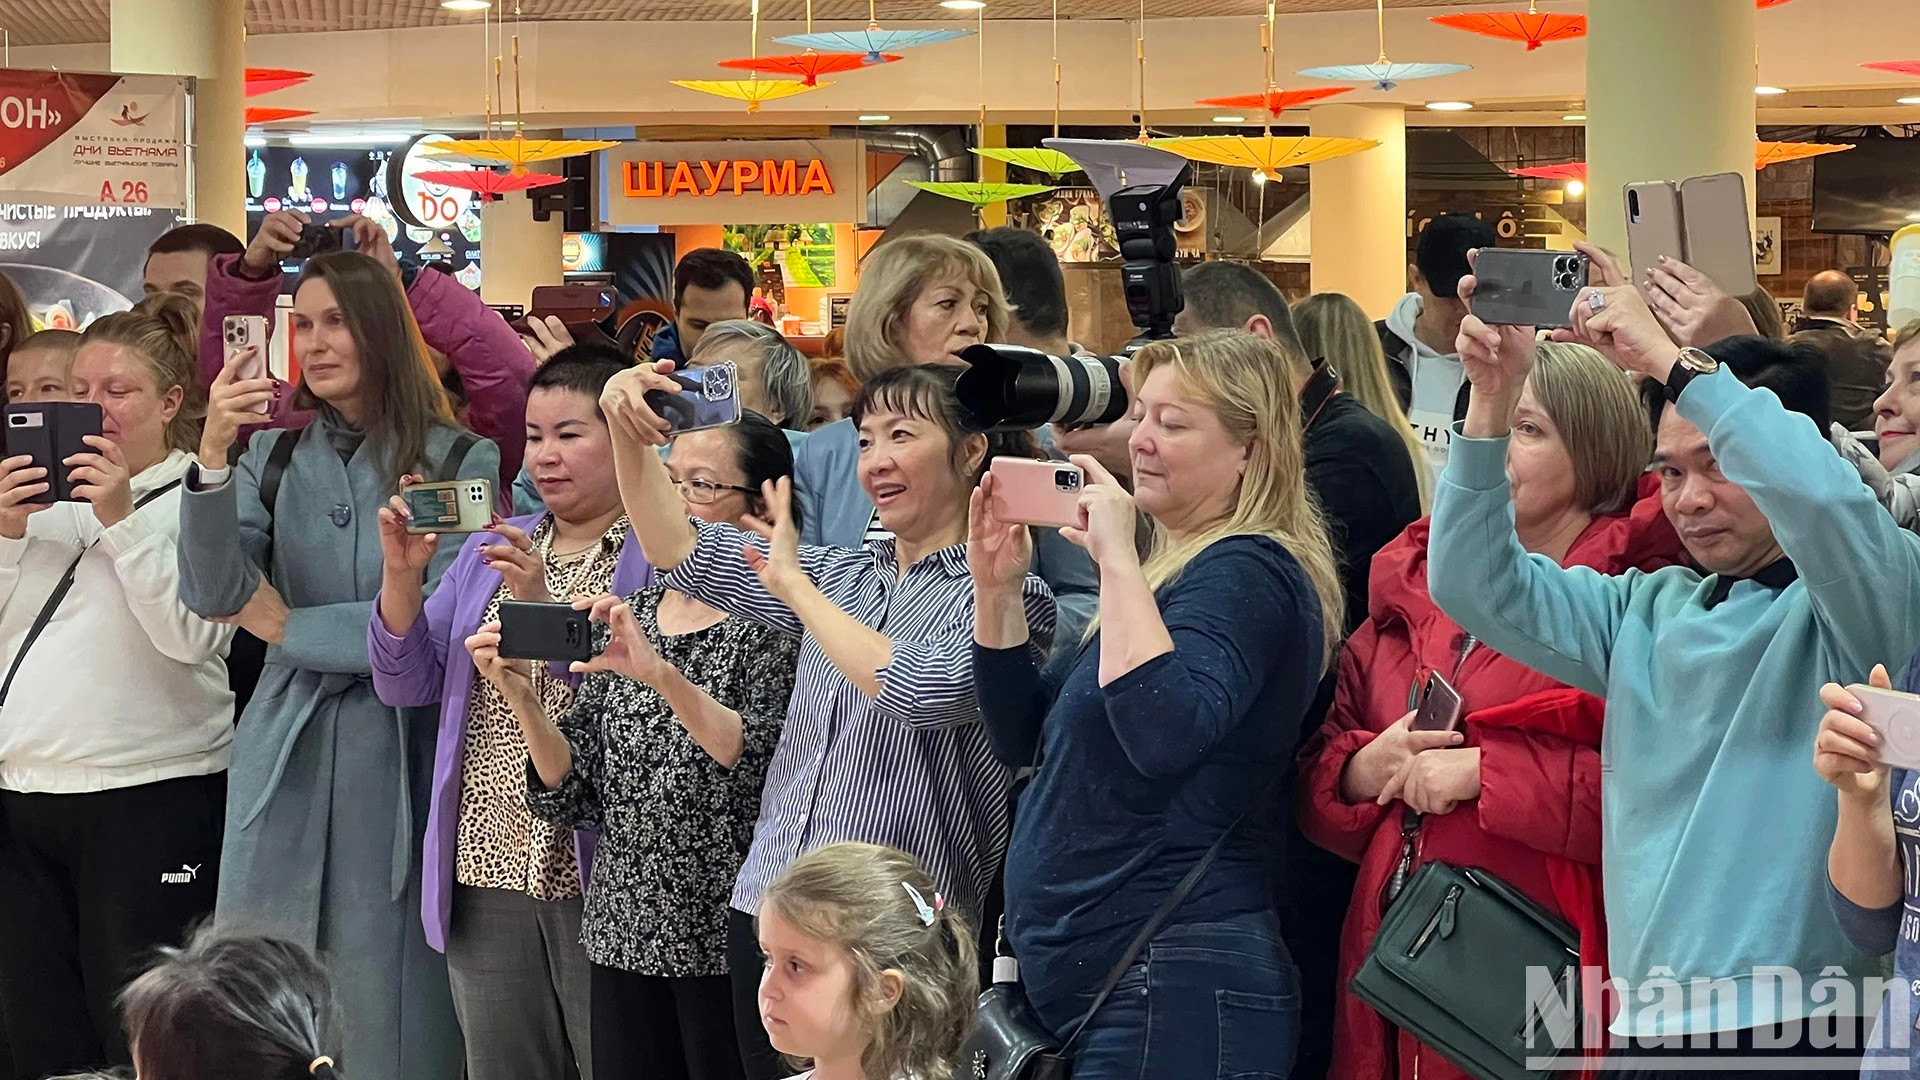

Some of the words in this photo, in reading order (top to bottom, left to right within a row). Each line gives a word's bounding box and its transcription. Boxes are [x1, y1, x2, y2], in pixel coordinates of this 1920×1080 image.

[73, 144, 102, 157] ДНИ
[107, 146, 178, 158] ВЬЕТНАМА
[622, 159, 835, 198] ШАУРМА
[121, 180, 149, 204] 26
[0, 203, 57, 221] ЧИСТЫЕ
[0, 231, 41, 251] ВКУС!
[161, 872, 192, 884] PUMA
